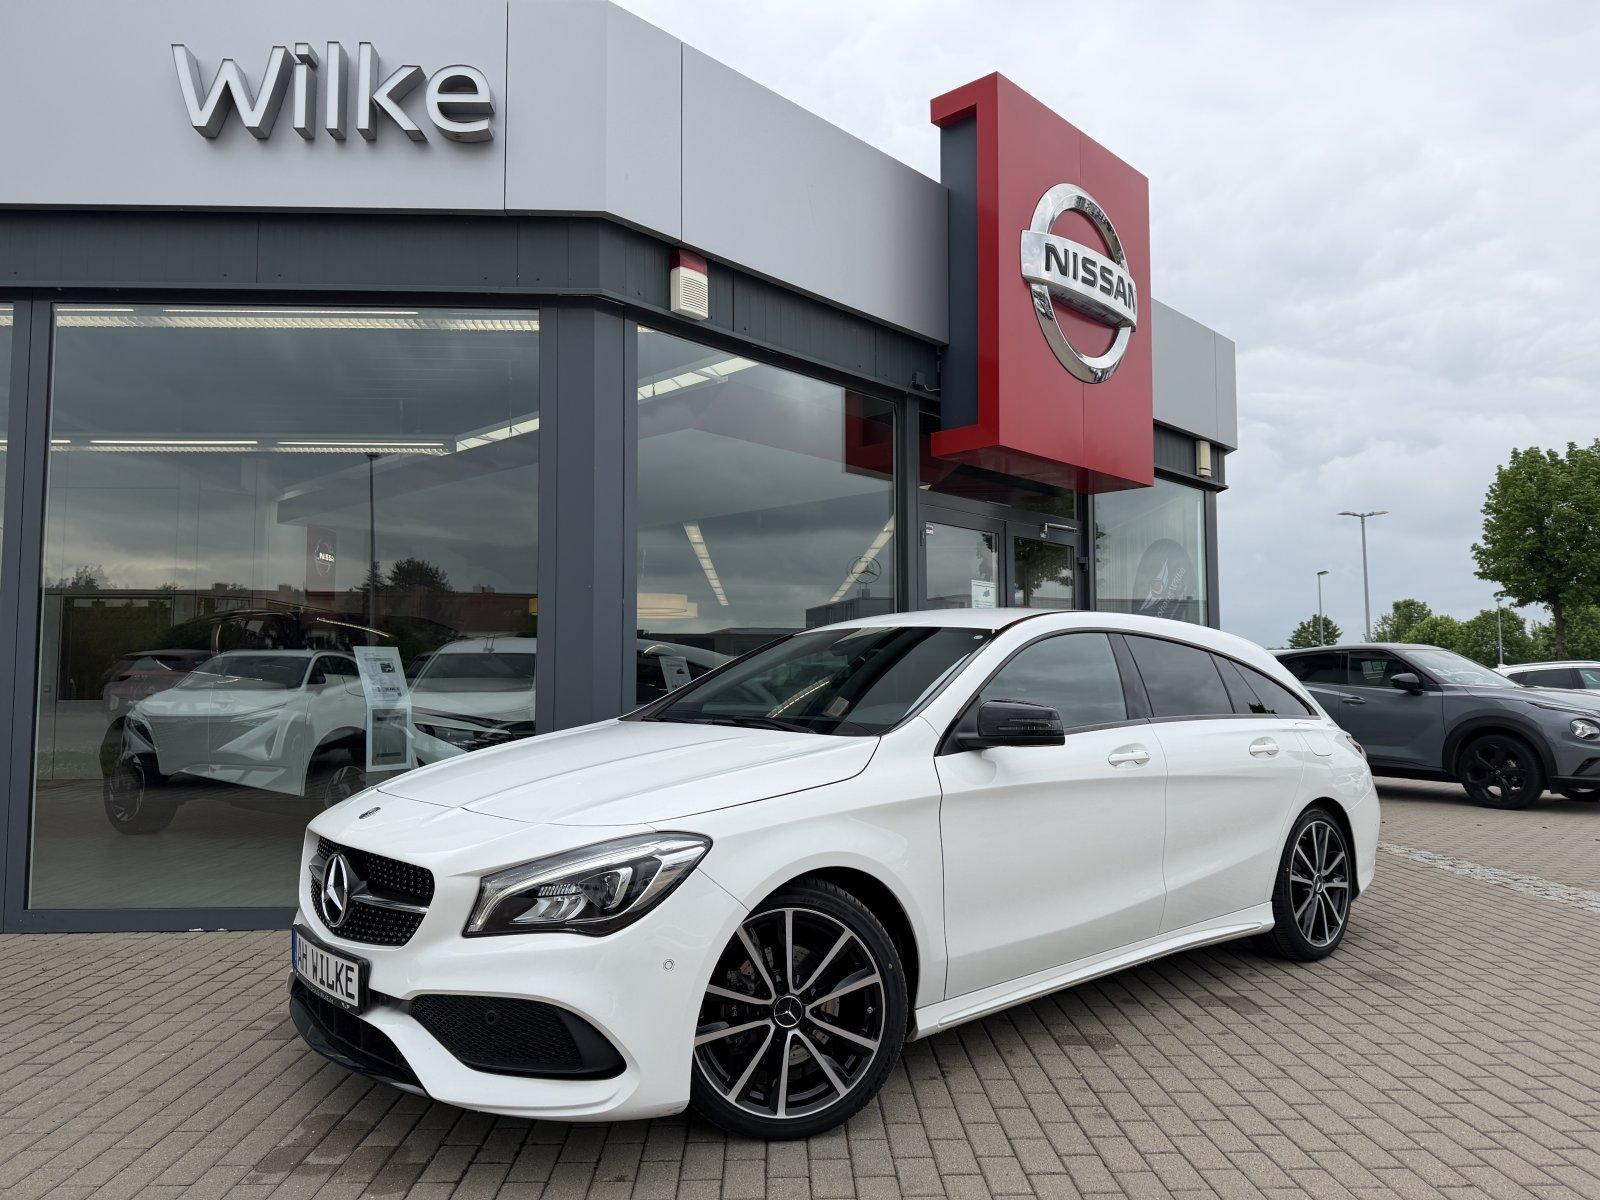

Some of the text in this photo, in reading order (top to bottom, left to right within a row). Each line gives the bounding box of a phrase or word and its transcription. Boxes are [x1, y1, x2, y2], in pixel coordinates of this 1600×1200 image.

[171, 41, 495, 144] Wilke
[1044, 242, 1135, 315] NISSAN
[312, 949, 356, 1000] WILKE
